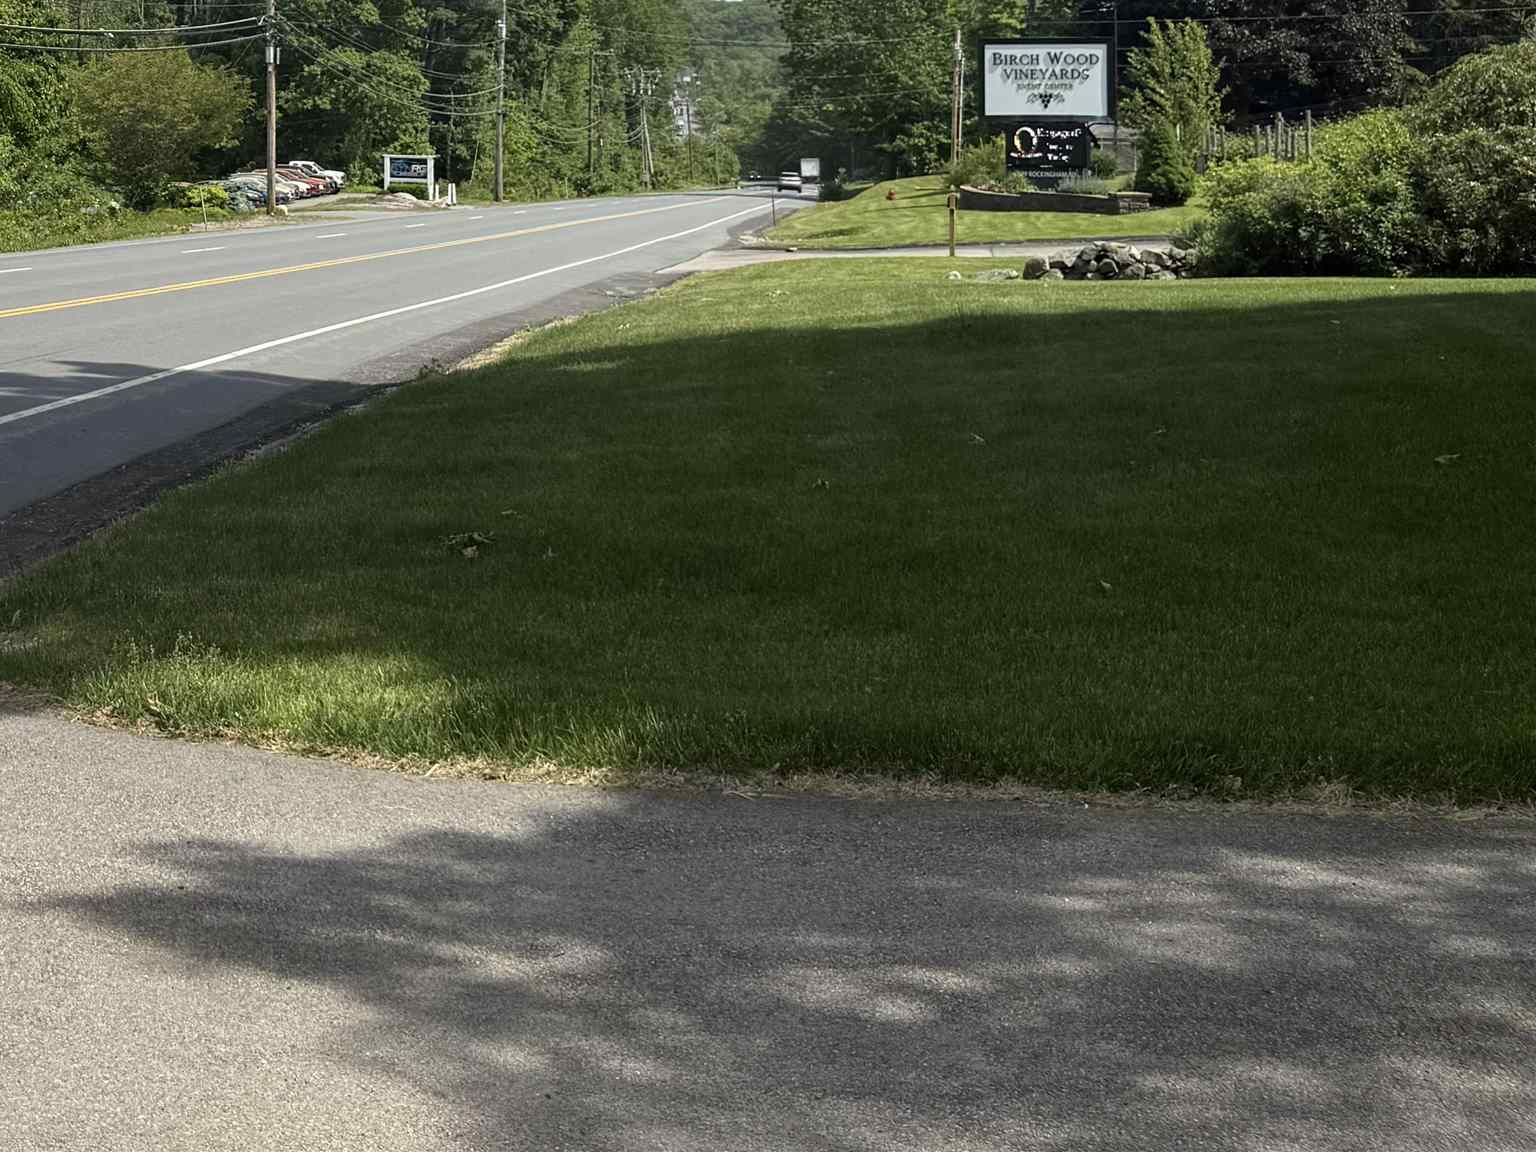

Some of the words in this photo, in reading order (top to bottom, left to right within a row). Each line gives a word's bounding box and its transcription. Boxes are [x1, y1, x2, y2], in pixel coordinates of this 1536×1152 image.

[992, 52, 1040, 66] BIRCH
[1047, 51, 1100, 65] WOOD
[1003, 68, 1090, 80] VINEYARDS
